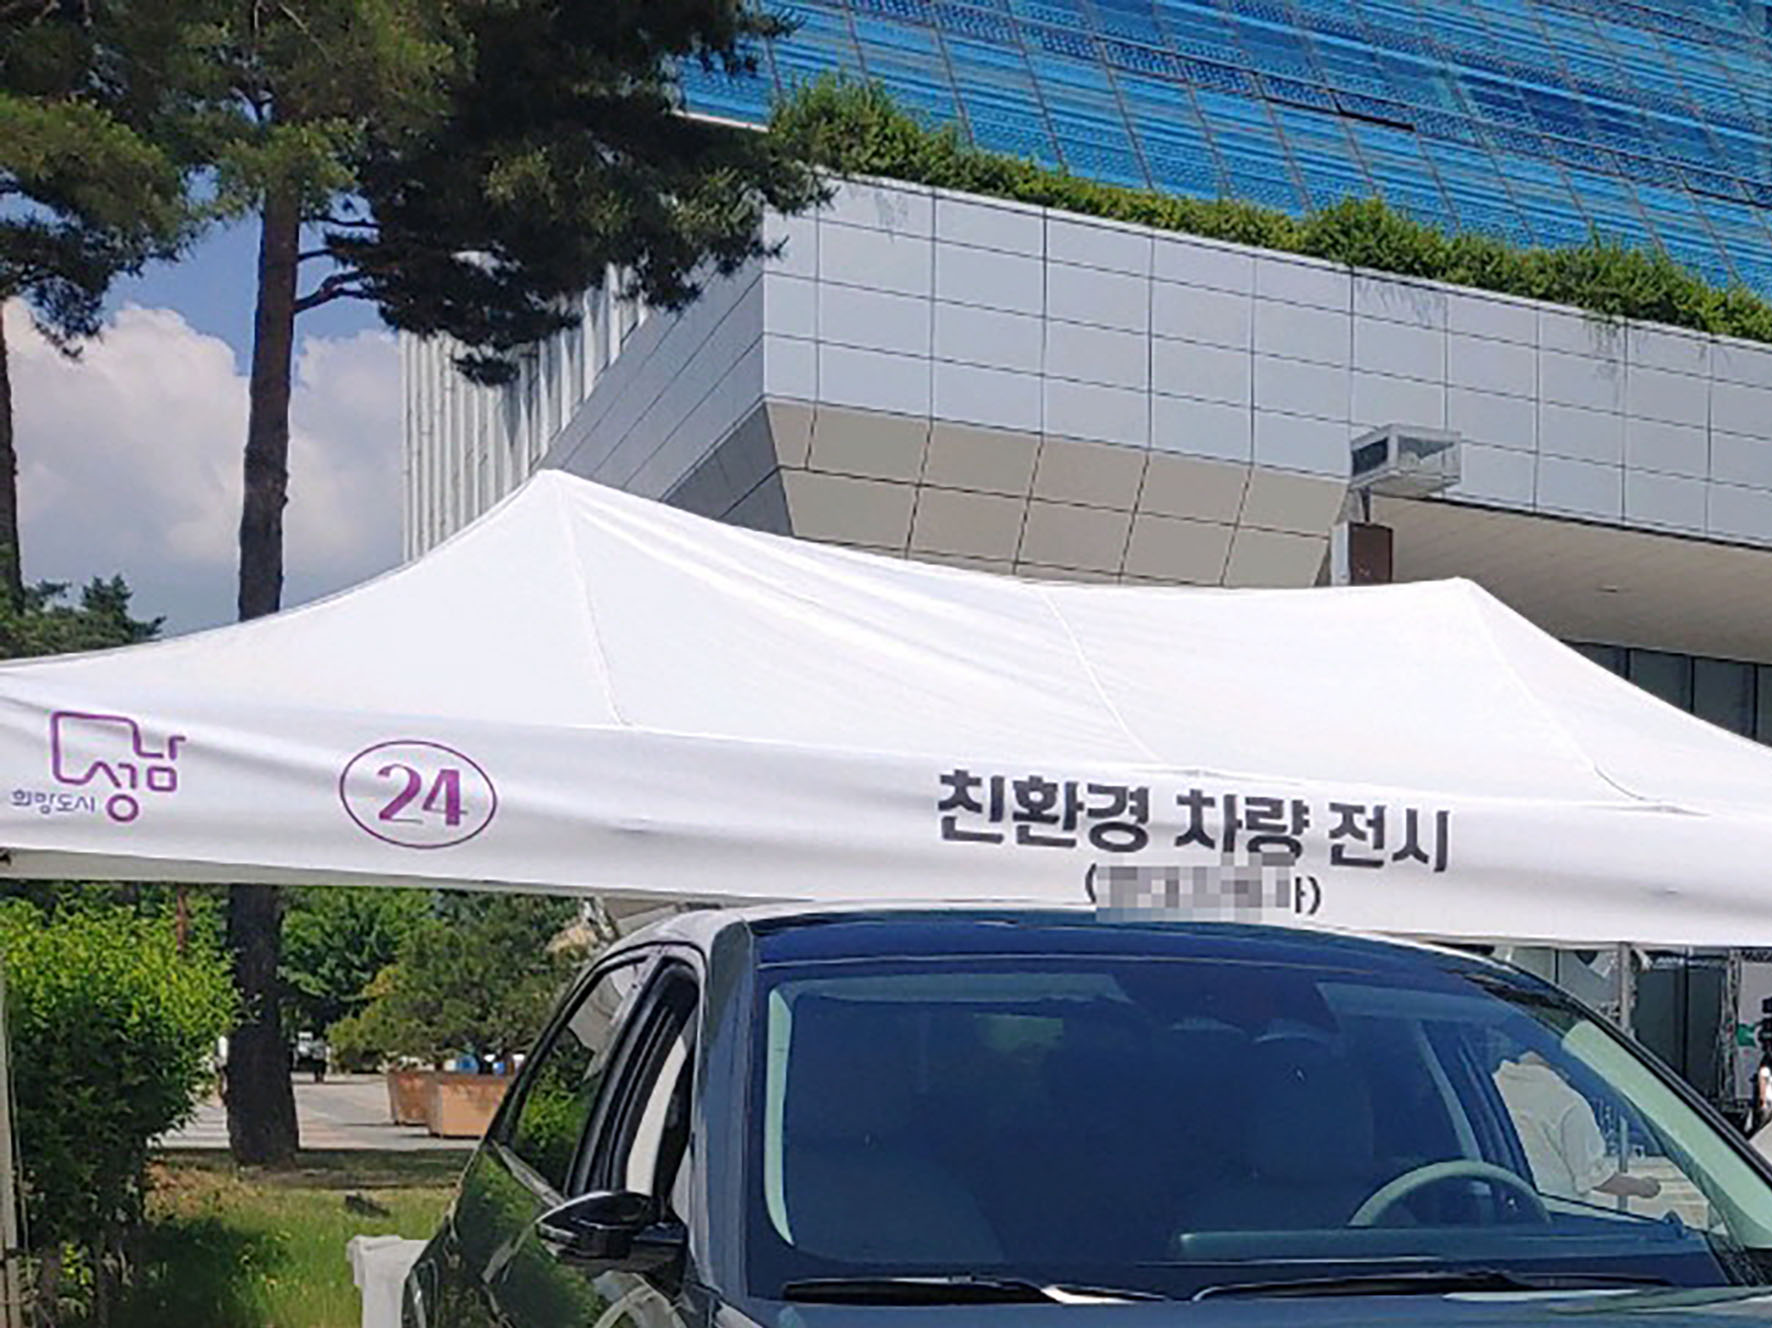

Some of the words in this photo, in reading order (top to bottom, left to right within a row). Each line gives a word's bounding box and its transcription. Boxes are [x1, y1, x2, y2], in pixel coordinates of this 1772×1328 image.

[11, 788, 96, 815] 희망도시
[377, 763, 469, 828] 24
[937, 768, 1150, 854] 친환경
[1174, 787, 1310, 867] 차량
[1328, 801, 1451, 873] 전시
